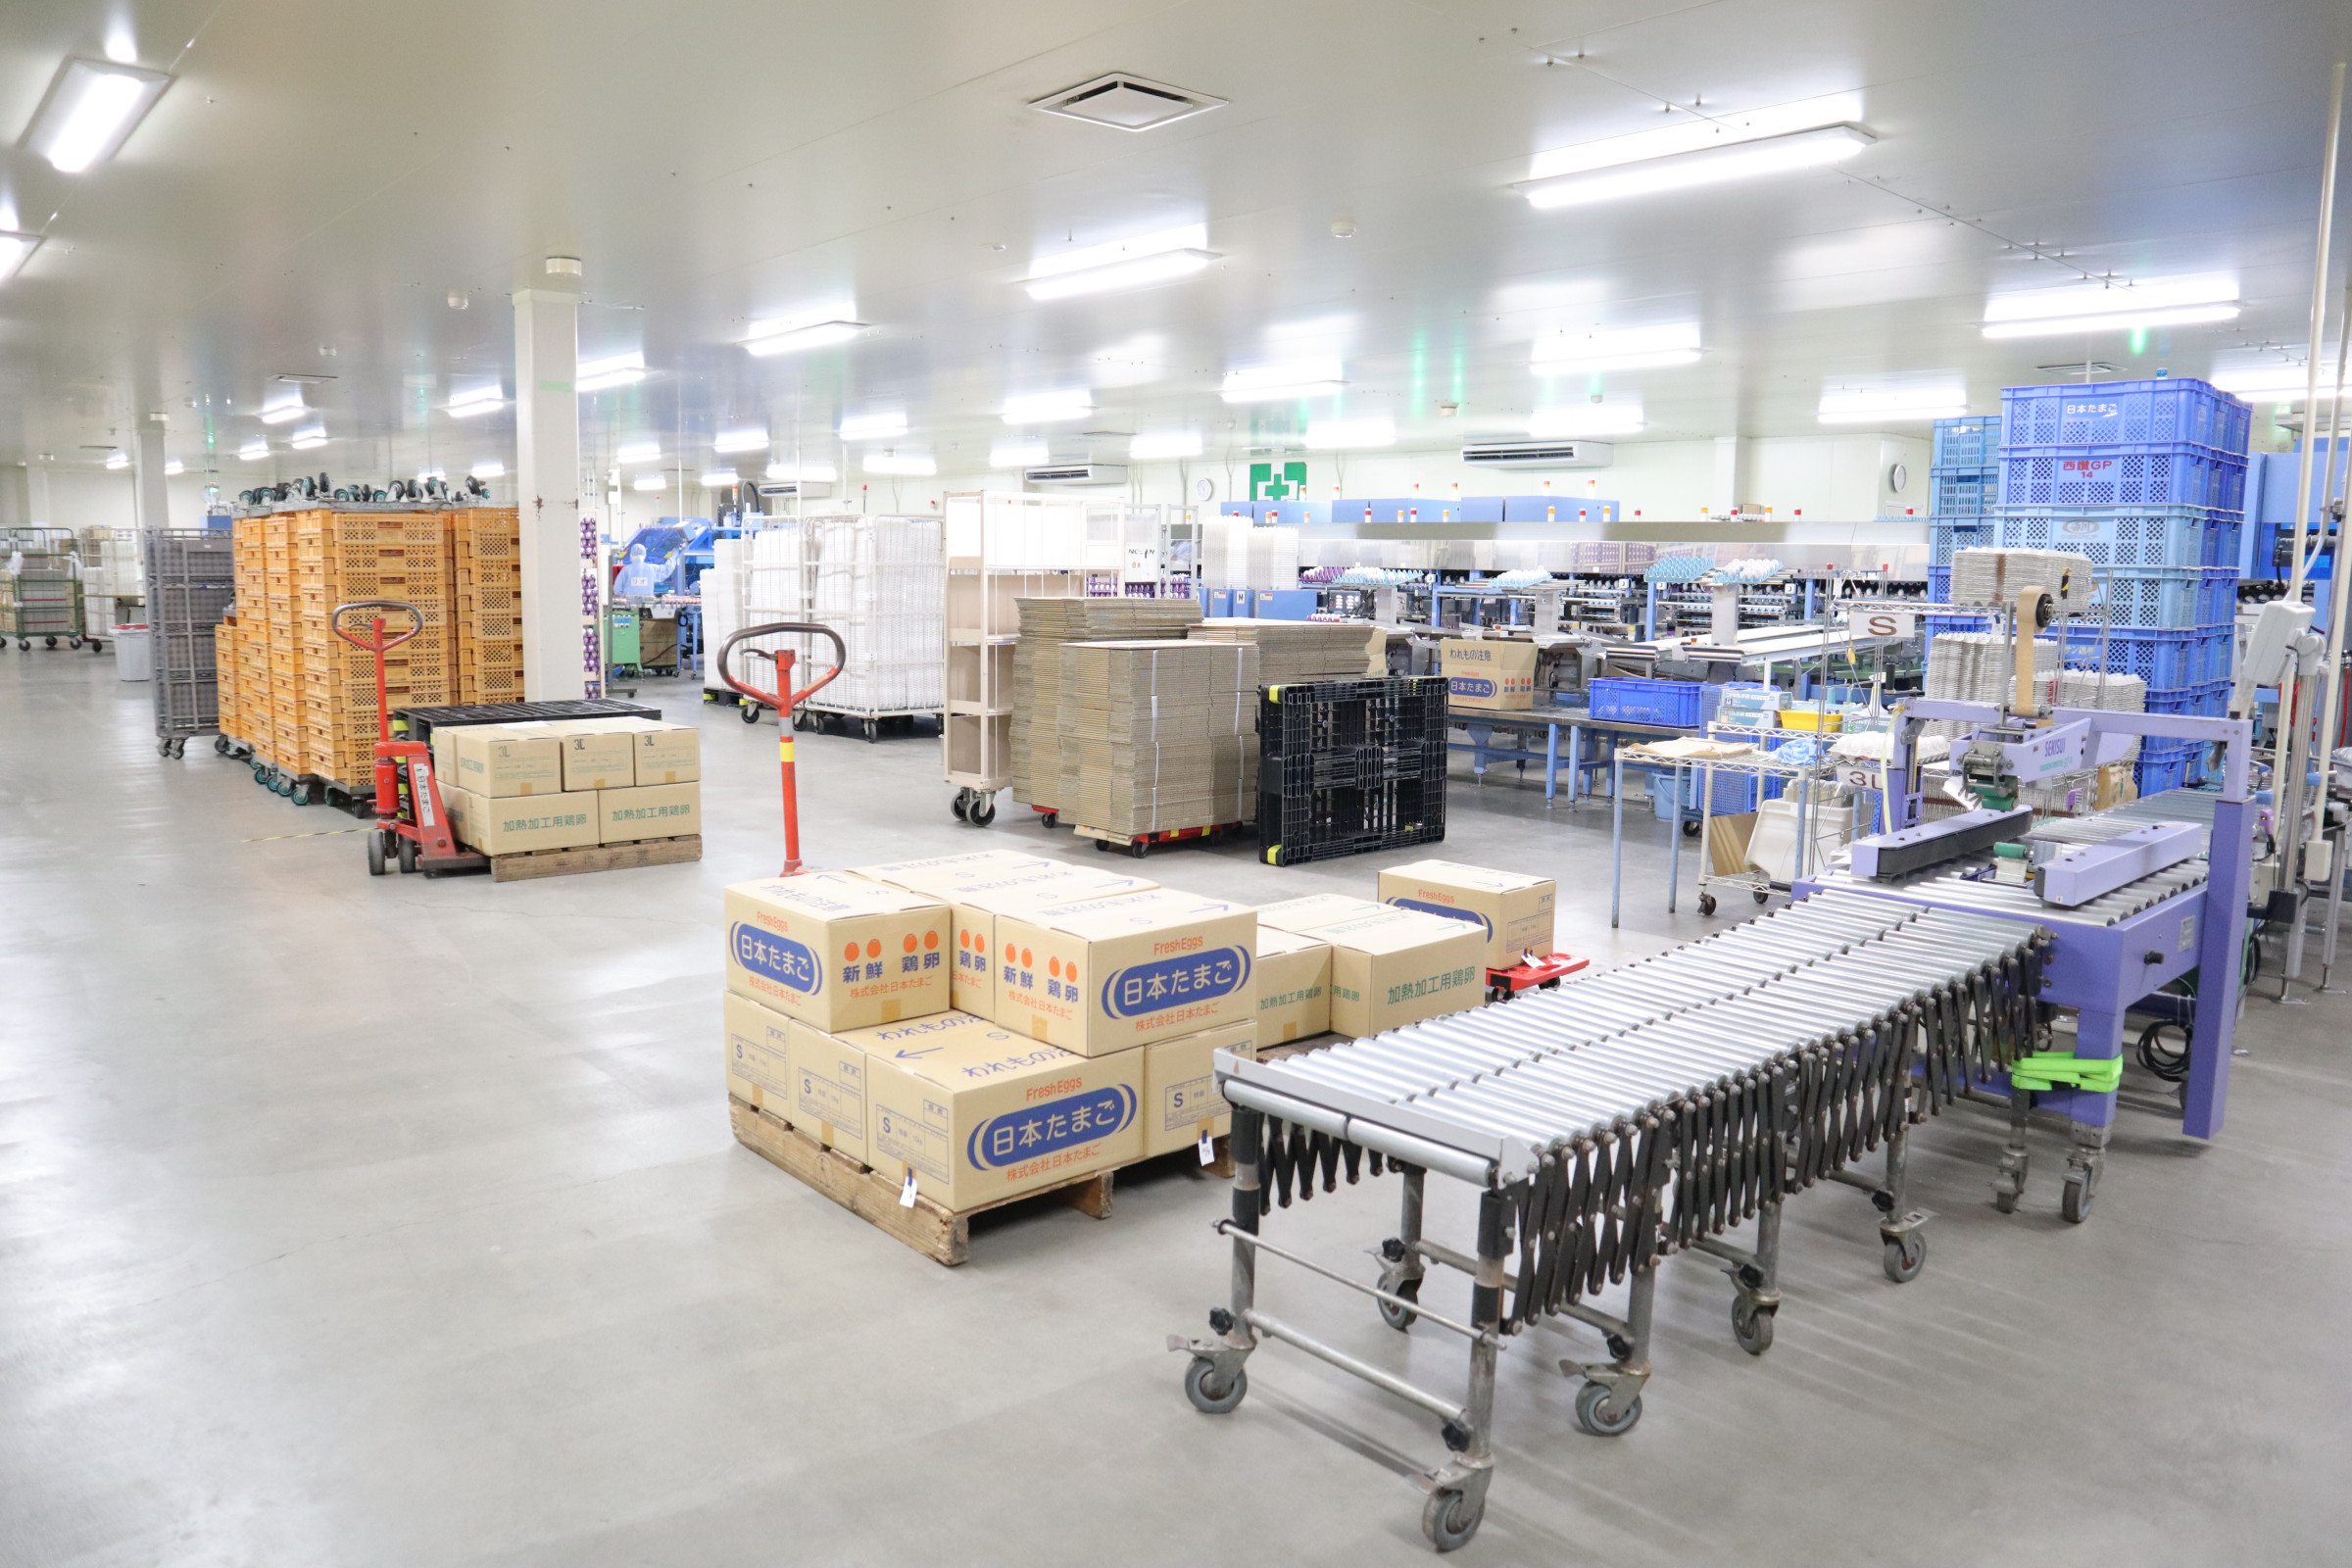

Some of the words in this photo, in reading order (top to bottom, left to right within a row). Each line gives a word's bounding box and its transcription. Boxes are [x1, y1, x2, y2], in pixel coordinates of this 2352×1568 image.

[1868, 615, 1897, 636] S
[1450, 680, 1491, 694] 日本たまご
[503, 813, 587, 832] 加熱加工用鶏卵
[612, 804, 691, 821] 加熱加工用鶏卵
[741, 934, 809, 982] 日本たまご
[843, 961, 883, 984] 新鮮
[902, 952, 940, 973] 鶏卵
[1004, 965, 1033, 991] 新鮮
[1048, 977, 1079, 1004] 鶏卵
[1124, 959, 1232, 1006] 日本たまご
[1388, 965, 1476, 1005] 加熱加工用鶏卵
[1260, 986, 1322, 1010] 加熱加工用鶏卵
[1135, 1002, 1220, 1033] 株式会社日本たまご
[986, 1032, 1010, 1041] S
[736, 1044, 744, 1059] S
[804, 1078, 811, 1095] S
[1173, 1092, 1184, 1108] S
[882, 1115, 892, 1134] S
[993, 1100, 1115, 1156] 日本たまご
[1006, 1143, 1102, 1182] 株式会社日本たまご
